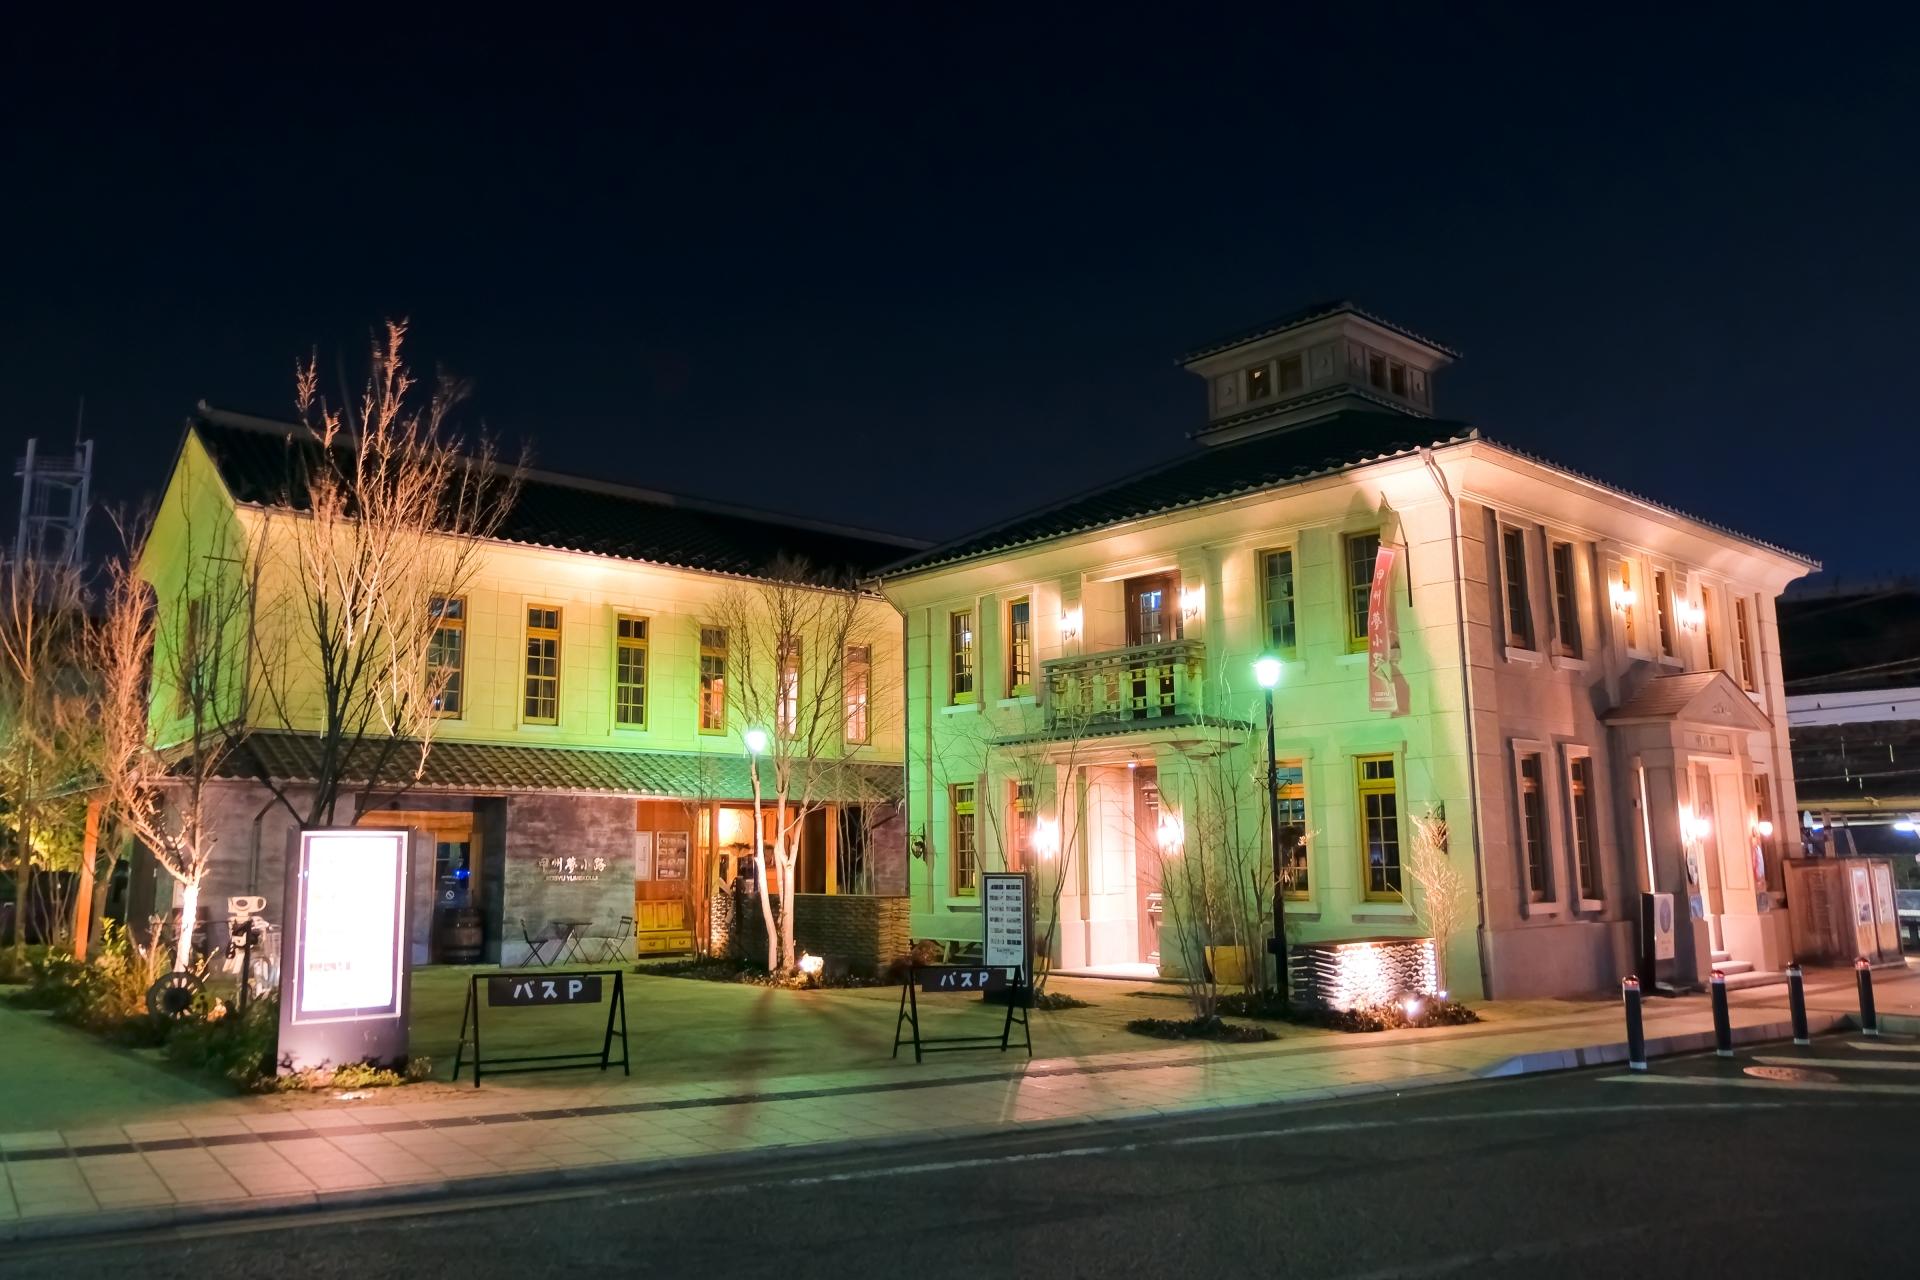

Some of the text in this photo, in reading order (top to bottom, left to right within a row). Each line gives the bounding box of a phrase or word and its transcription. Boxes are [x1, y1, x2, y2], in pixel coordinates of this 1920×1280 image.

[538, 856, 607, 873] 甲州夢小路
[940, 971, 989, 987] バスP
[513, 979, 583, 1000] バスP
